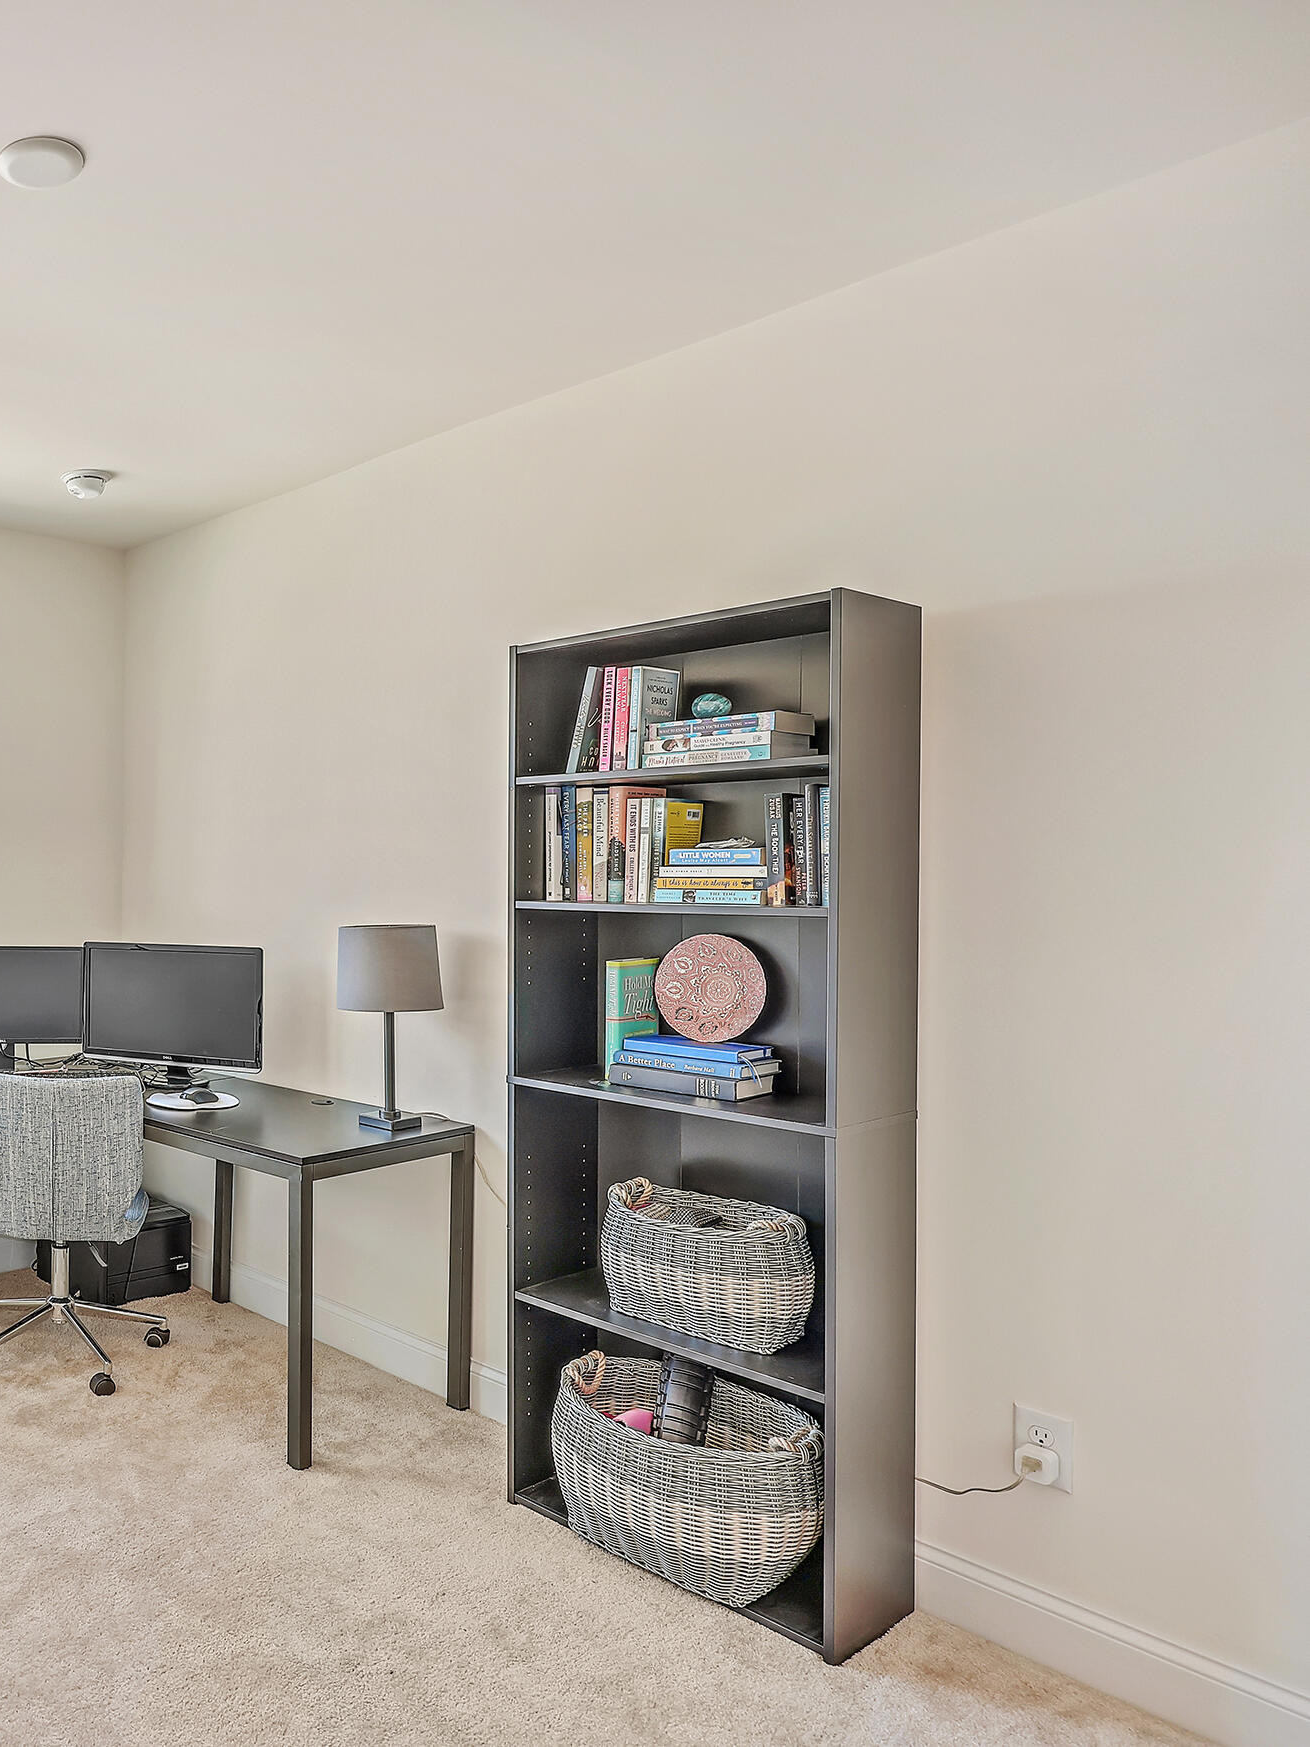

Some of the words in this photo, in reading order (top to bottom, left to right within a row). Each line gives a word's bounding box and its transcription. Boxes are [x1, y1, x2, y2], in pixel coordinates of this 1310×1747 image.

[646, 684, 673, 695] NICHOLAS
[650, 696, 668, 706] SPARKS
[596, 798, 605, 833] Beautiful
[795, 802, 803, 818] HER
[629, 811, 637, 827] ENDS
[770, 823, 778, 837] THE
[796, 820, 804, 844] EVERY
[596, 836, 605, 857] Mind
[628, 844, 636, 853] US
[771, 837, 779, 856] BOOK
[624, 976, 643, 991] Hold
[643, 975, 654, 988] Me
[624, 990, 654, 1020] Tight
[618, 1054, 626, 1062] A
[628, 1055, 652, 1066] Better
[654, 1058, 676, 1069] Place
